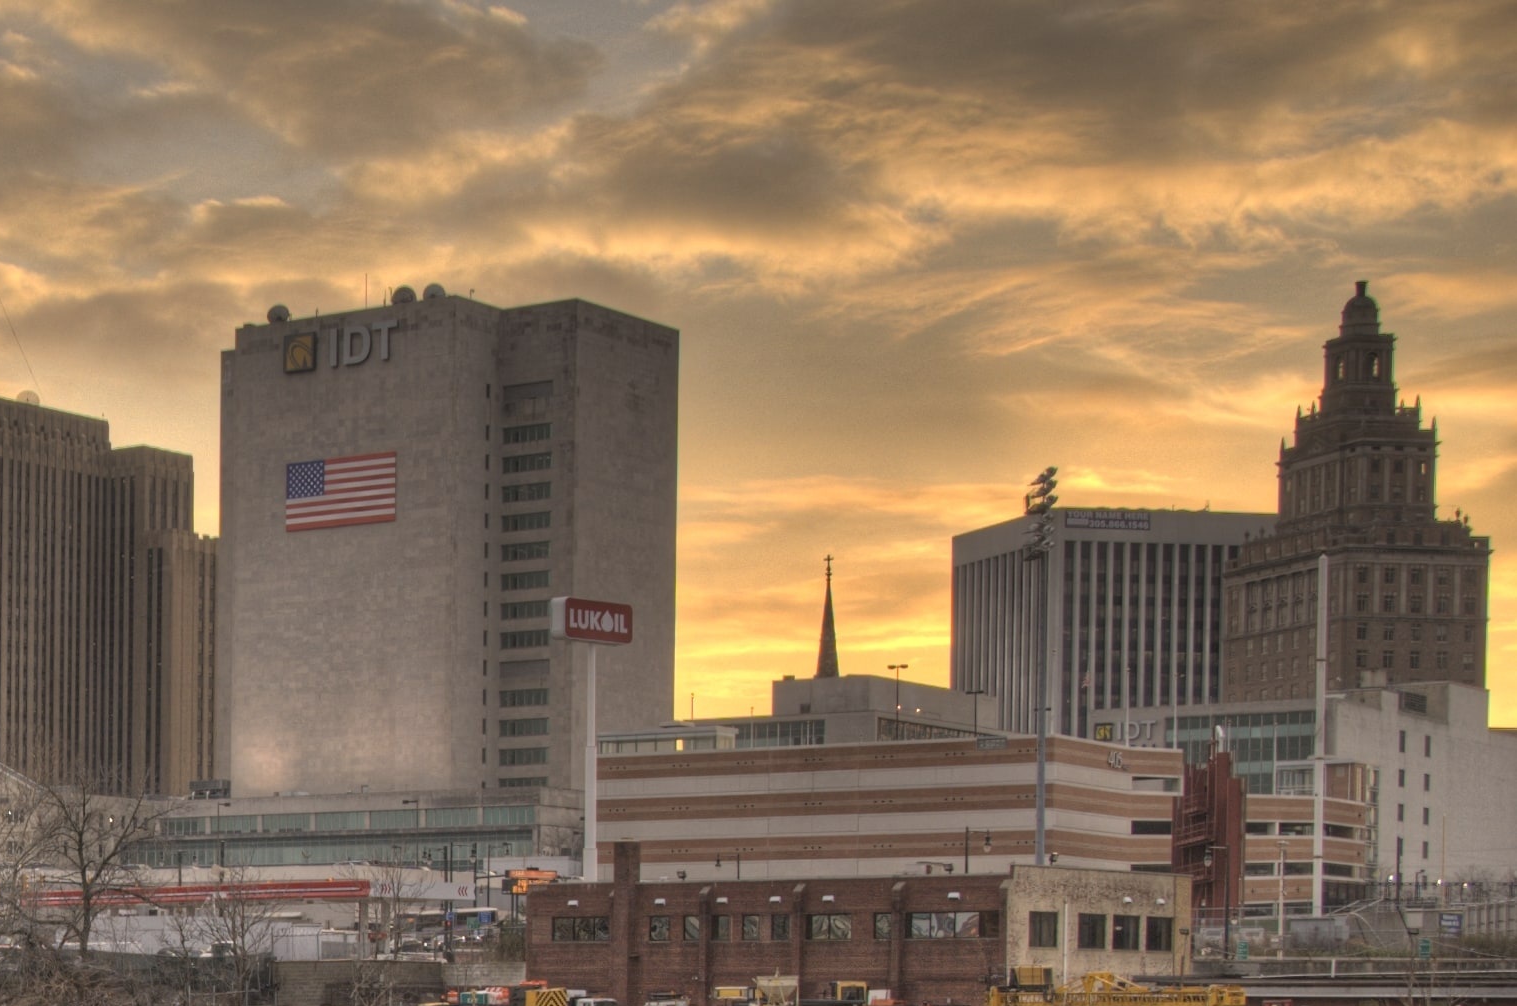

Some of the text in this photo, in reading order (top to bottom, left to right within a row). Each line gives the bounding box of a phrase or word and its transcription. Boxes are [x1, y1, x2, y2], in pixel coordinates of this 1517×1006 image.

[329, 319, 399, 368] IDT
[1067, 510, 1149, 521] YOUR NAME HERE
[569, 607, 628, 634] LUKOIL
[1117, 720, 1158, 740] IDT
